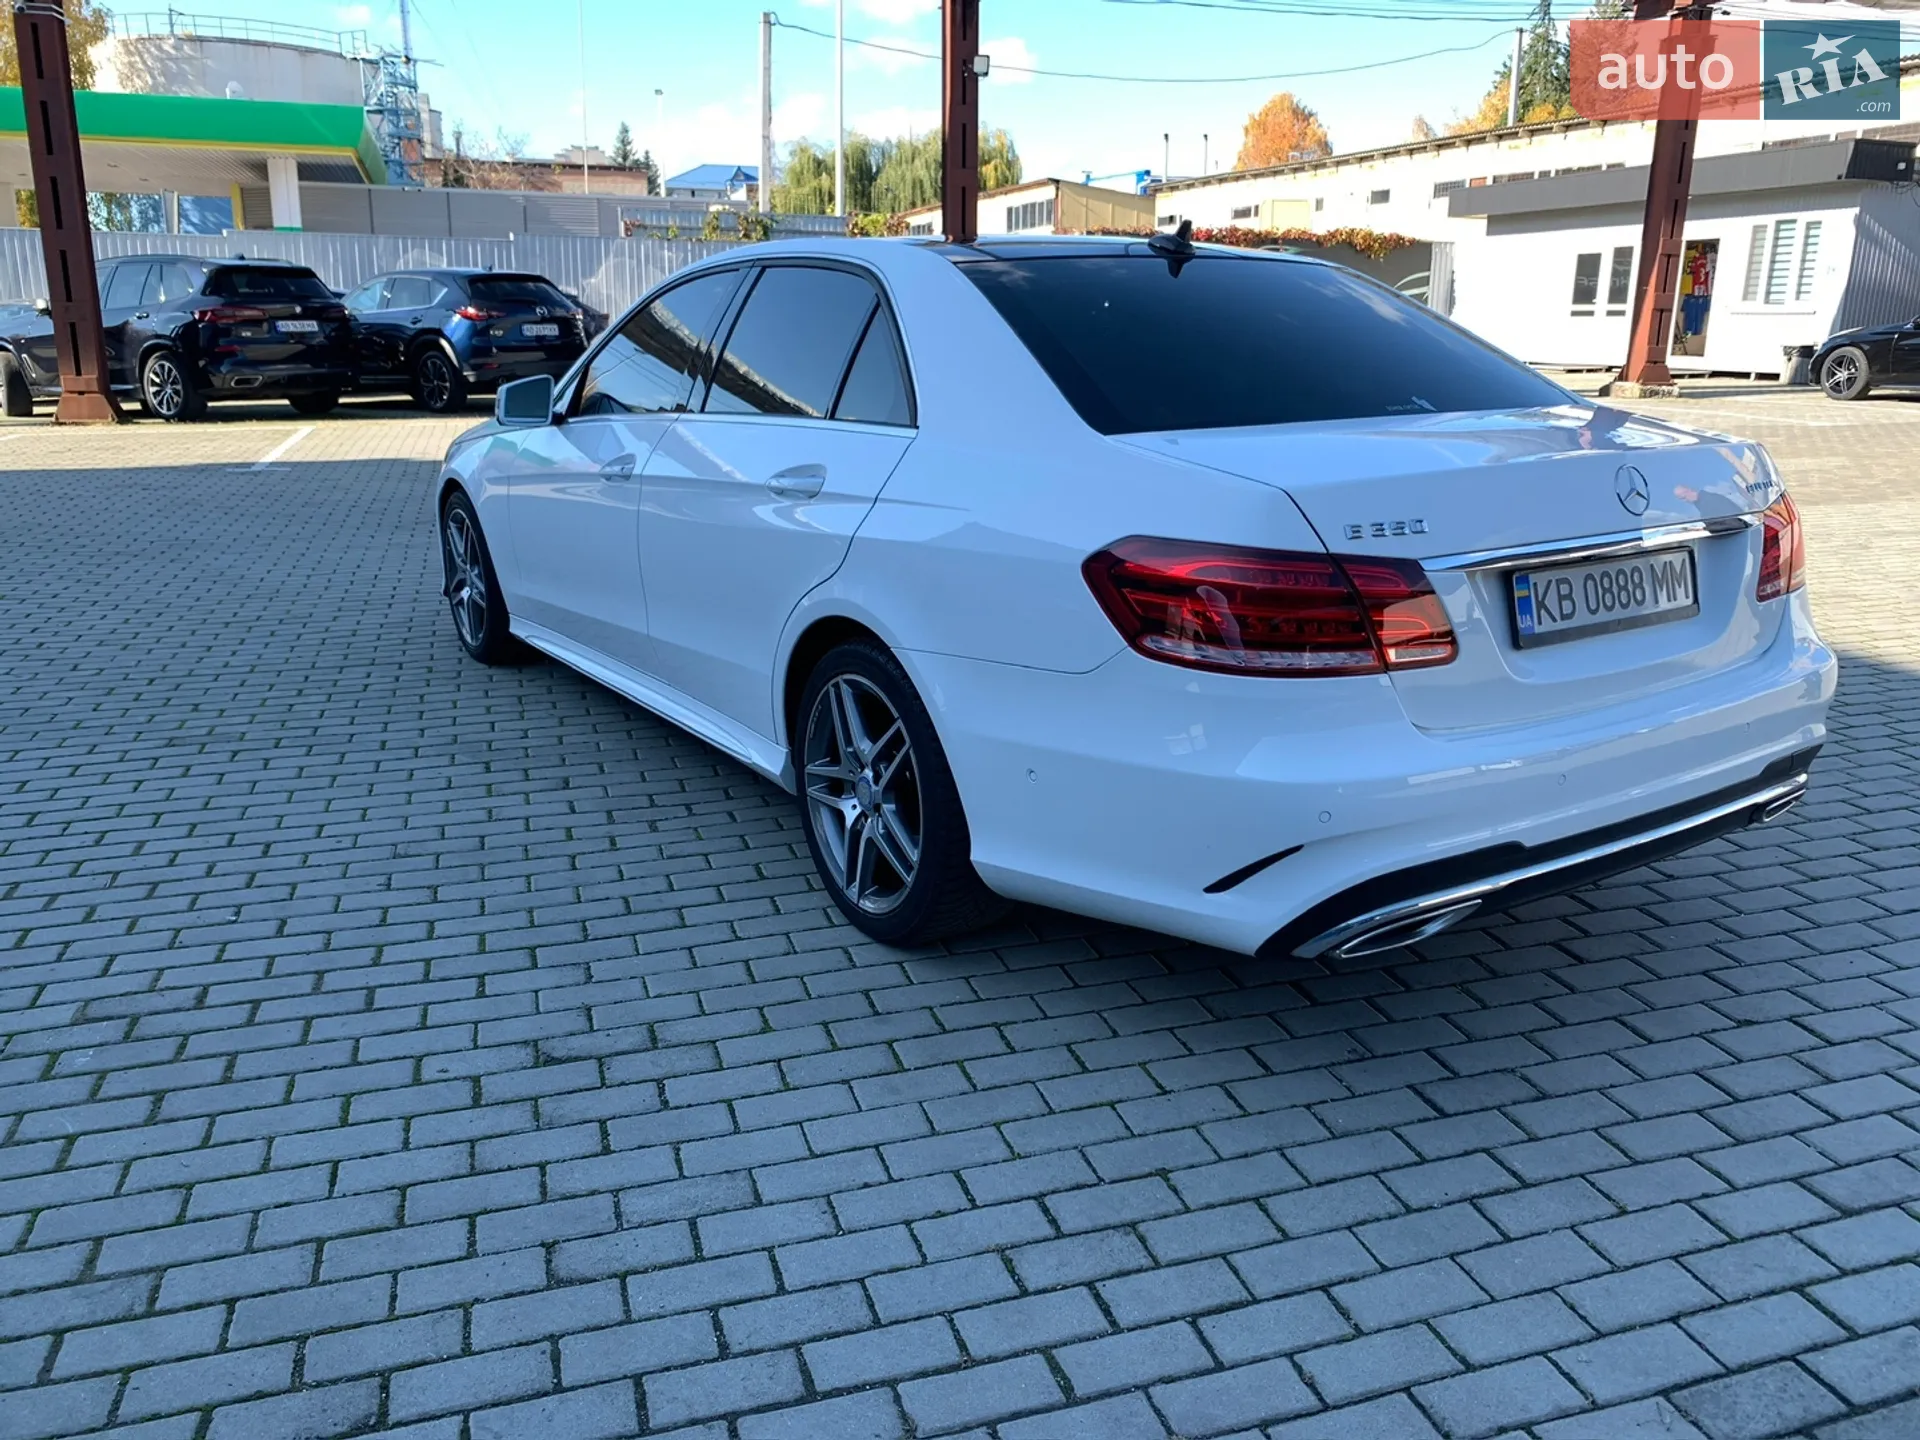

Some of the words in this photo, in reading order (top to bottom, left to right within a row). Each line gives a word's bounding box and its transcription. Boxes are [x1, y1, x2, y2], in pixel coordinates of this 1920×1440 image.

[1344, 524, 1365, 540] E
[1370, 519, 1428, 537] 350
[1533, 577, 1576, 626] KB
[1583, 565, 1646, 615] 0888
[1650, 558, 1690, 606] MM
[1519, 615, 1533, 628] UA
